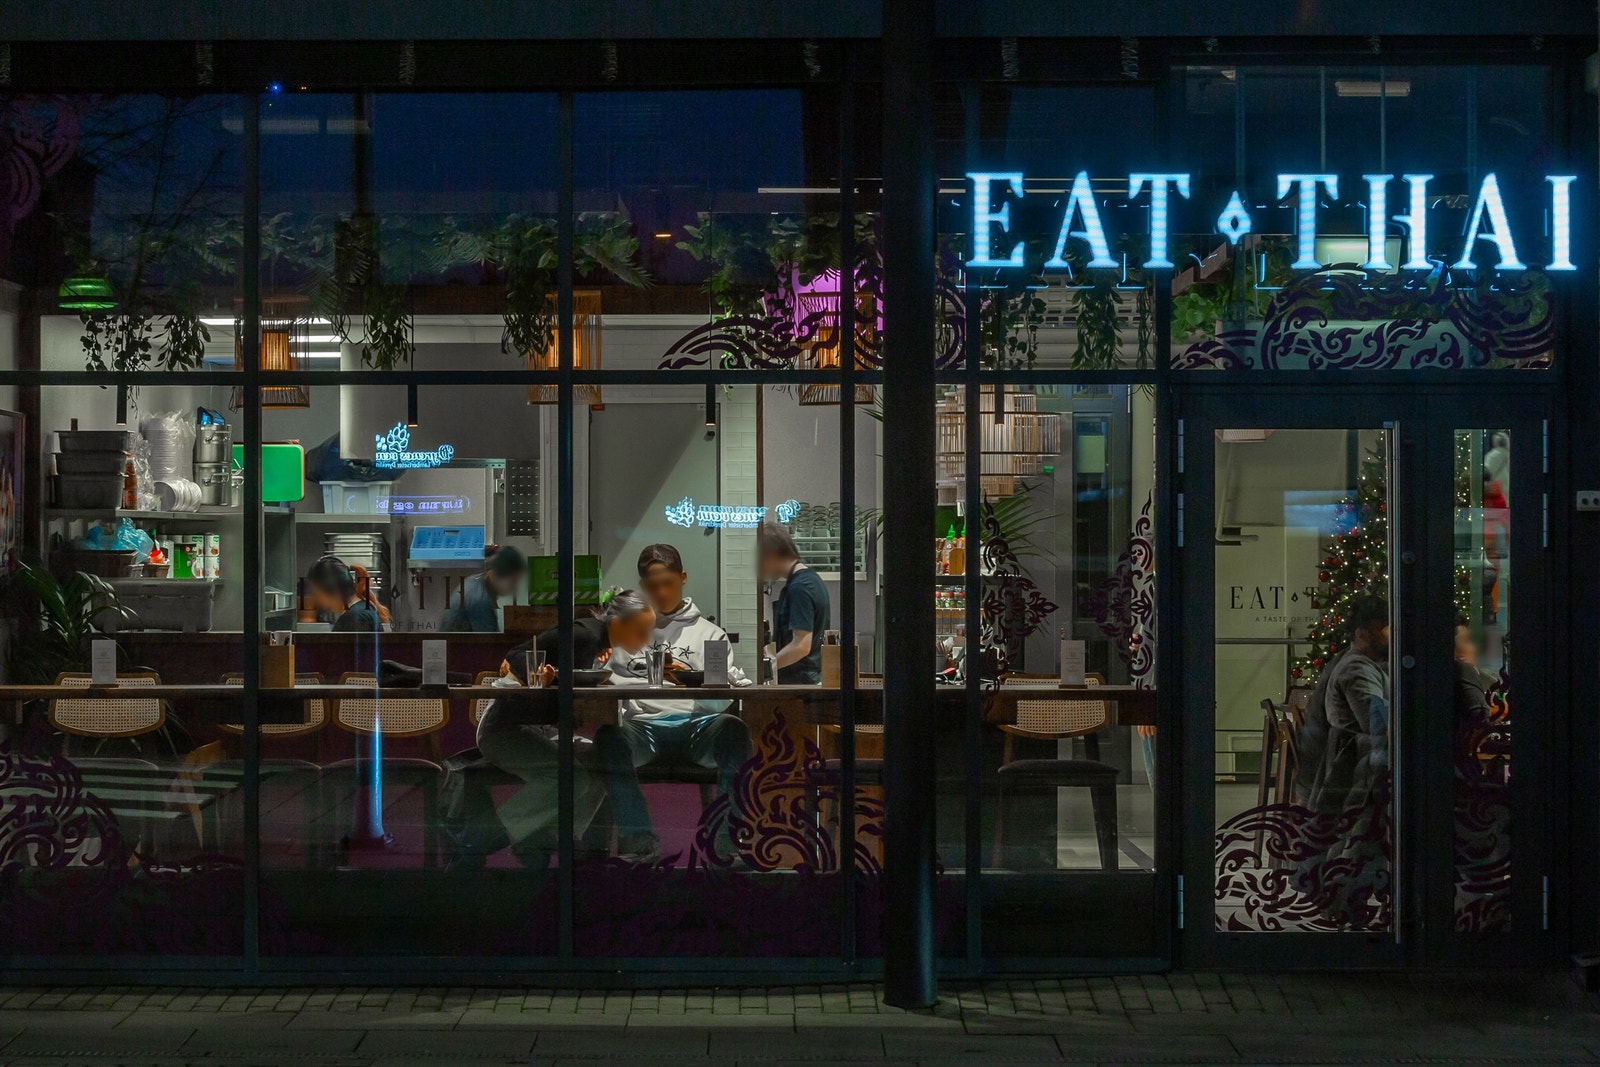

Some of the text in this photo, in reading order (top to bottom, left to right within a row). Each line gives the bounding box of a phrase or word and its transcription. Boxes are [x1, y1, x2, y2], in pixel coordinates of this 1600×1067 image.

[965, 170, 1578, 271] EAT THAI
[1230, 586, 1284, 610] EAT
[389, 621, 436, 630] OF THAI
